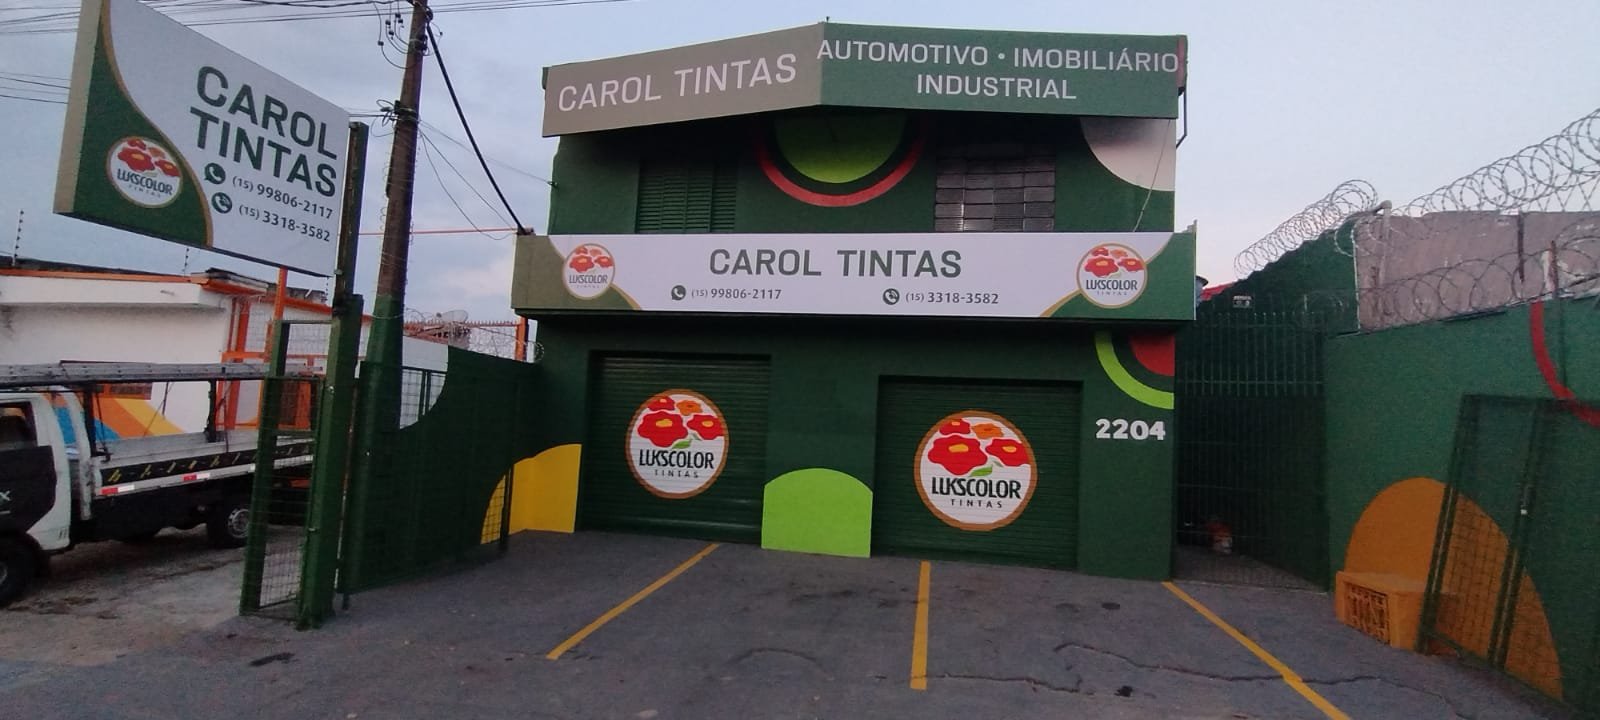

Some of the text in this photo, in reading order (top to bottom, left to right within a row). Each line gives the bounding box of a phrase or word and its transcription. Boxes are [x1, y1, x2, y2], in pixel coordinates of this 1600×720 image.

[817, 40, 1179, 73] AUTOMOTIVO IMOBILIÁRIO
[558, 53, 798, 112] CAROL TINTAS
[917, 74, 1077, 100] INDUSTRIAL
[196, 66, 338, 160] CAROL
[190, 106, 337, 198] TINTAS
[117, 168, 173, 196] LUKSCOLOR
[232, 175, 333, 220] (15) 99806-2117
[238, 204, 330, 242] (15) 3318-3582
[710, 248, 962, 278] CAROL TINTAS
[569, 274, 608, 284] LUKSCOLOR
[1086, 279, 1138, 290] LUKSCOLOR
[691, 287, 782, 301] (15) 99806-2117
[905, 291, 999, 305] (15) 3318-3582
[1095, 418, 1166, 441] 2204
[639, 448, 715, 470] LUKSCOLOR
[654, 468, 699, 479] TINTAS
[931, 476, 1022, 500] LUKSCOLOR
[951, 498, 1003, 509] TINTAS
